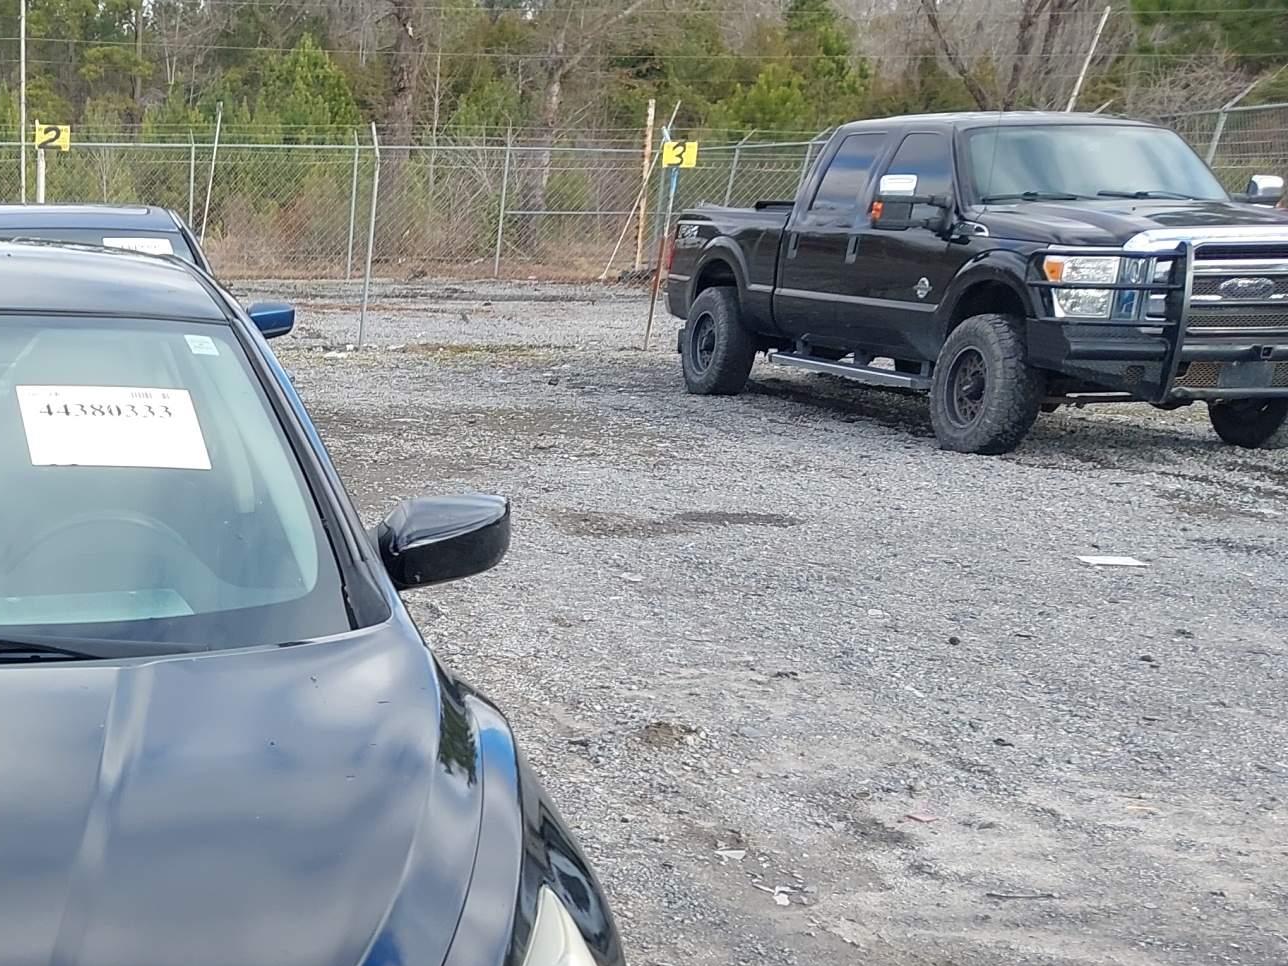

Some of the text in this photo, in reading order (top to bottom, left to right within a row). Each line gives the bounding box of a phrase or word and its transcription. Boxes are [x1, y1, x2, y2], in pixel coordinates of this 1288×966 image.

[38, 126, 62, 149] 2
[667, 140, 686, 166] 3
[39, 403, 173, 418] 44380333
